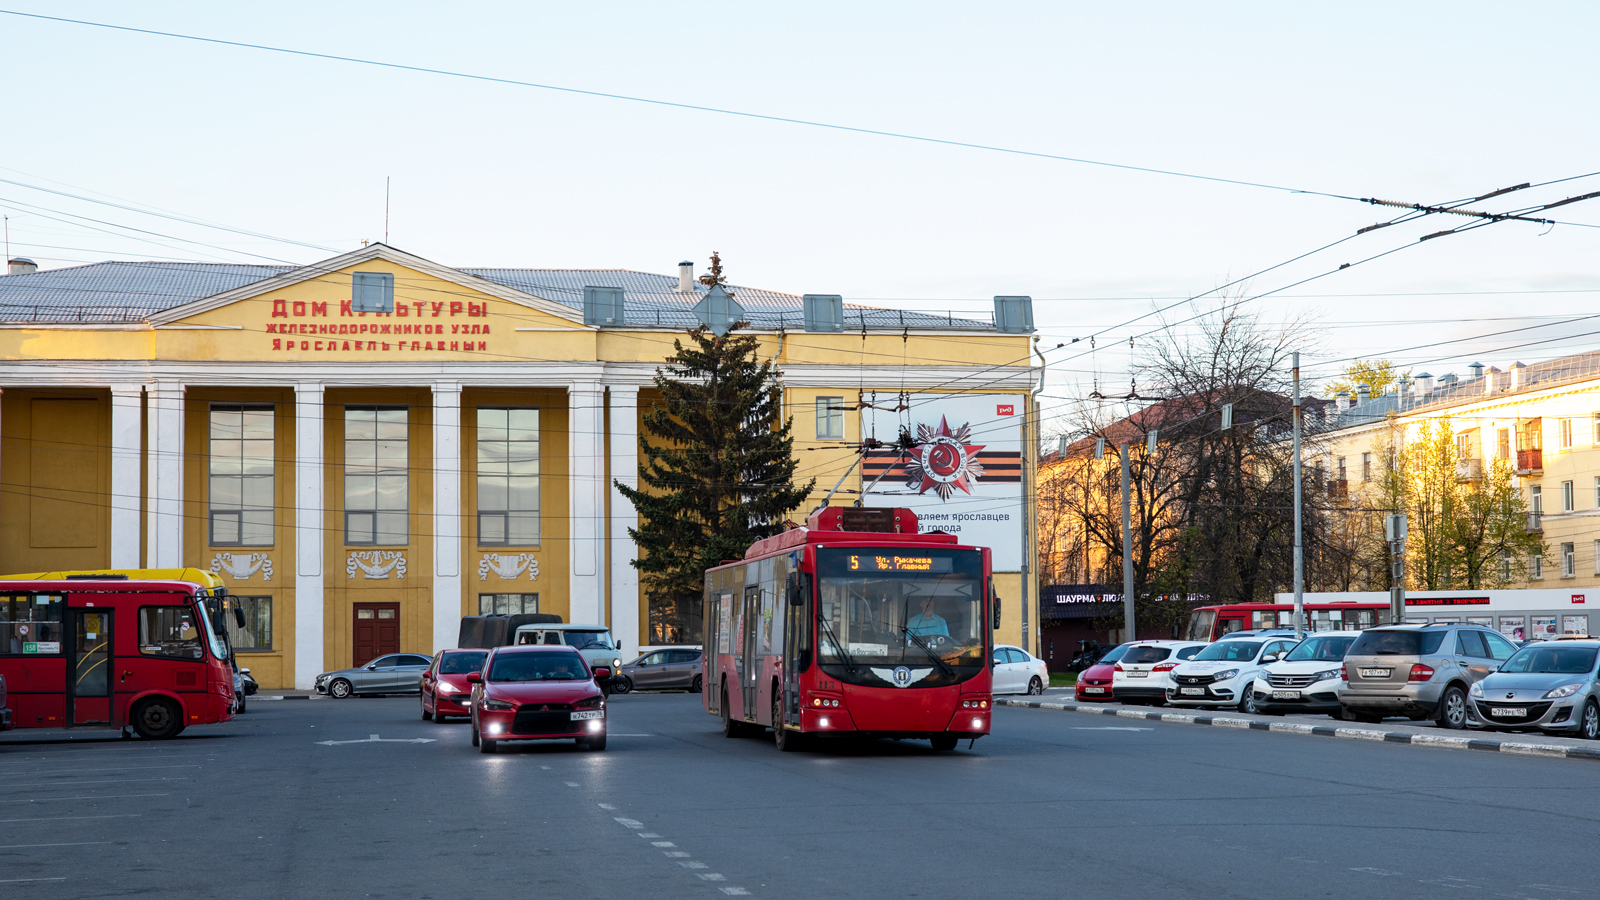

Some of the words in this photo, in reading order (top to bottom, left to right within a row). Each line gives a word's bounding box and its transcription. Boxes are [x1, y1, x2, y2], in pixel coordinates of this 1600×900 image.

[271, 299, 327, 318] ДОМ
[340, 300, 487, 317] КЬТУРЫ
[266, 323, 443, 335] ЖЕЛЕЗНОДОРОЖНИКОВ
[451, 324, 490, 334] УЗЛА
[272, 338, 390, 351] ЯРОСЛАВЛЬ
[917, 513, 949, 521] вляем
[952, 513, 1010, 522] ярославцев
[927, 524, 962, 533] города
[851, 555, 859, 569] 5
[894, 556, 932, 564] Рыкачева
[1056, 594, 1096, 604] ШАУРМА
